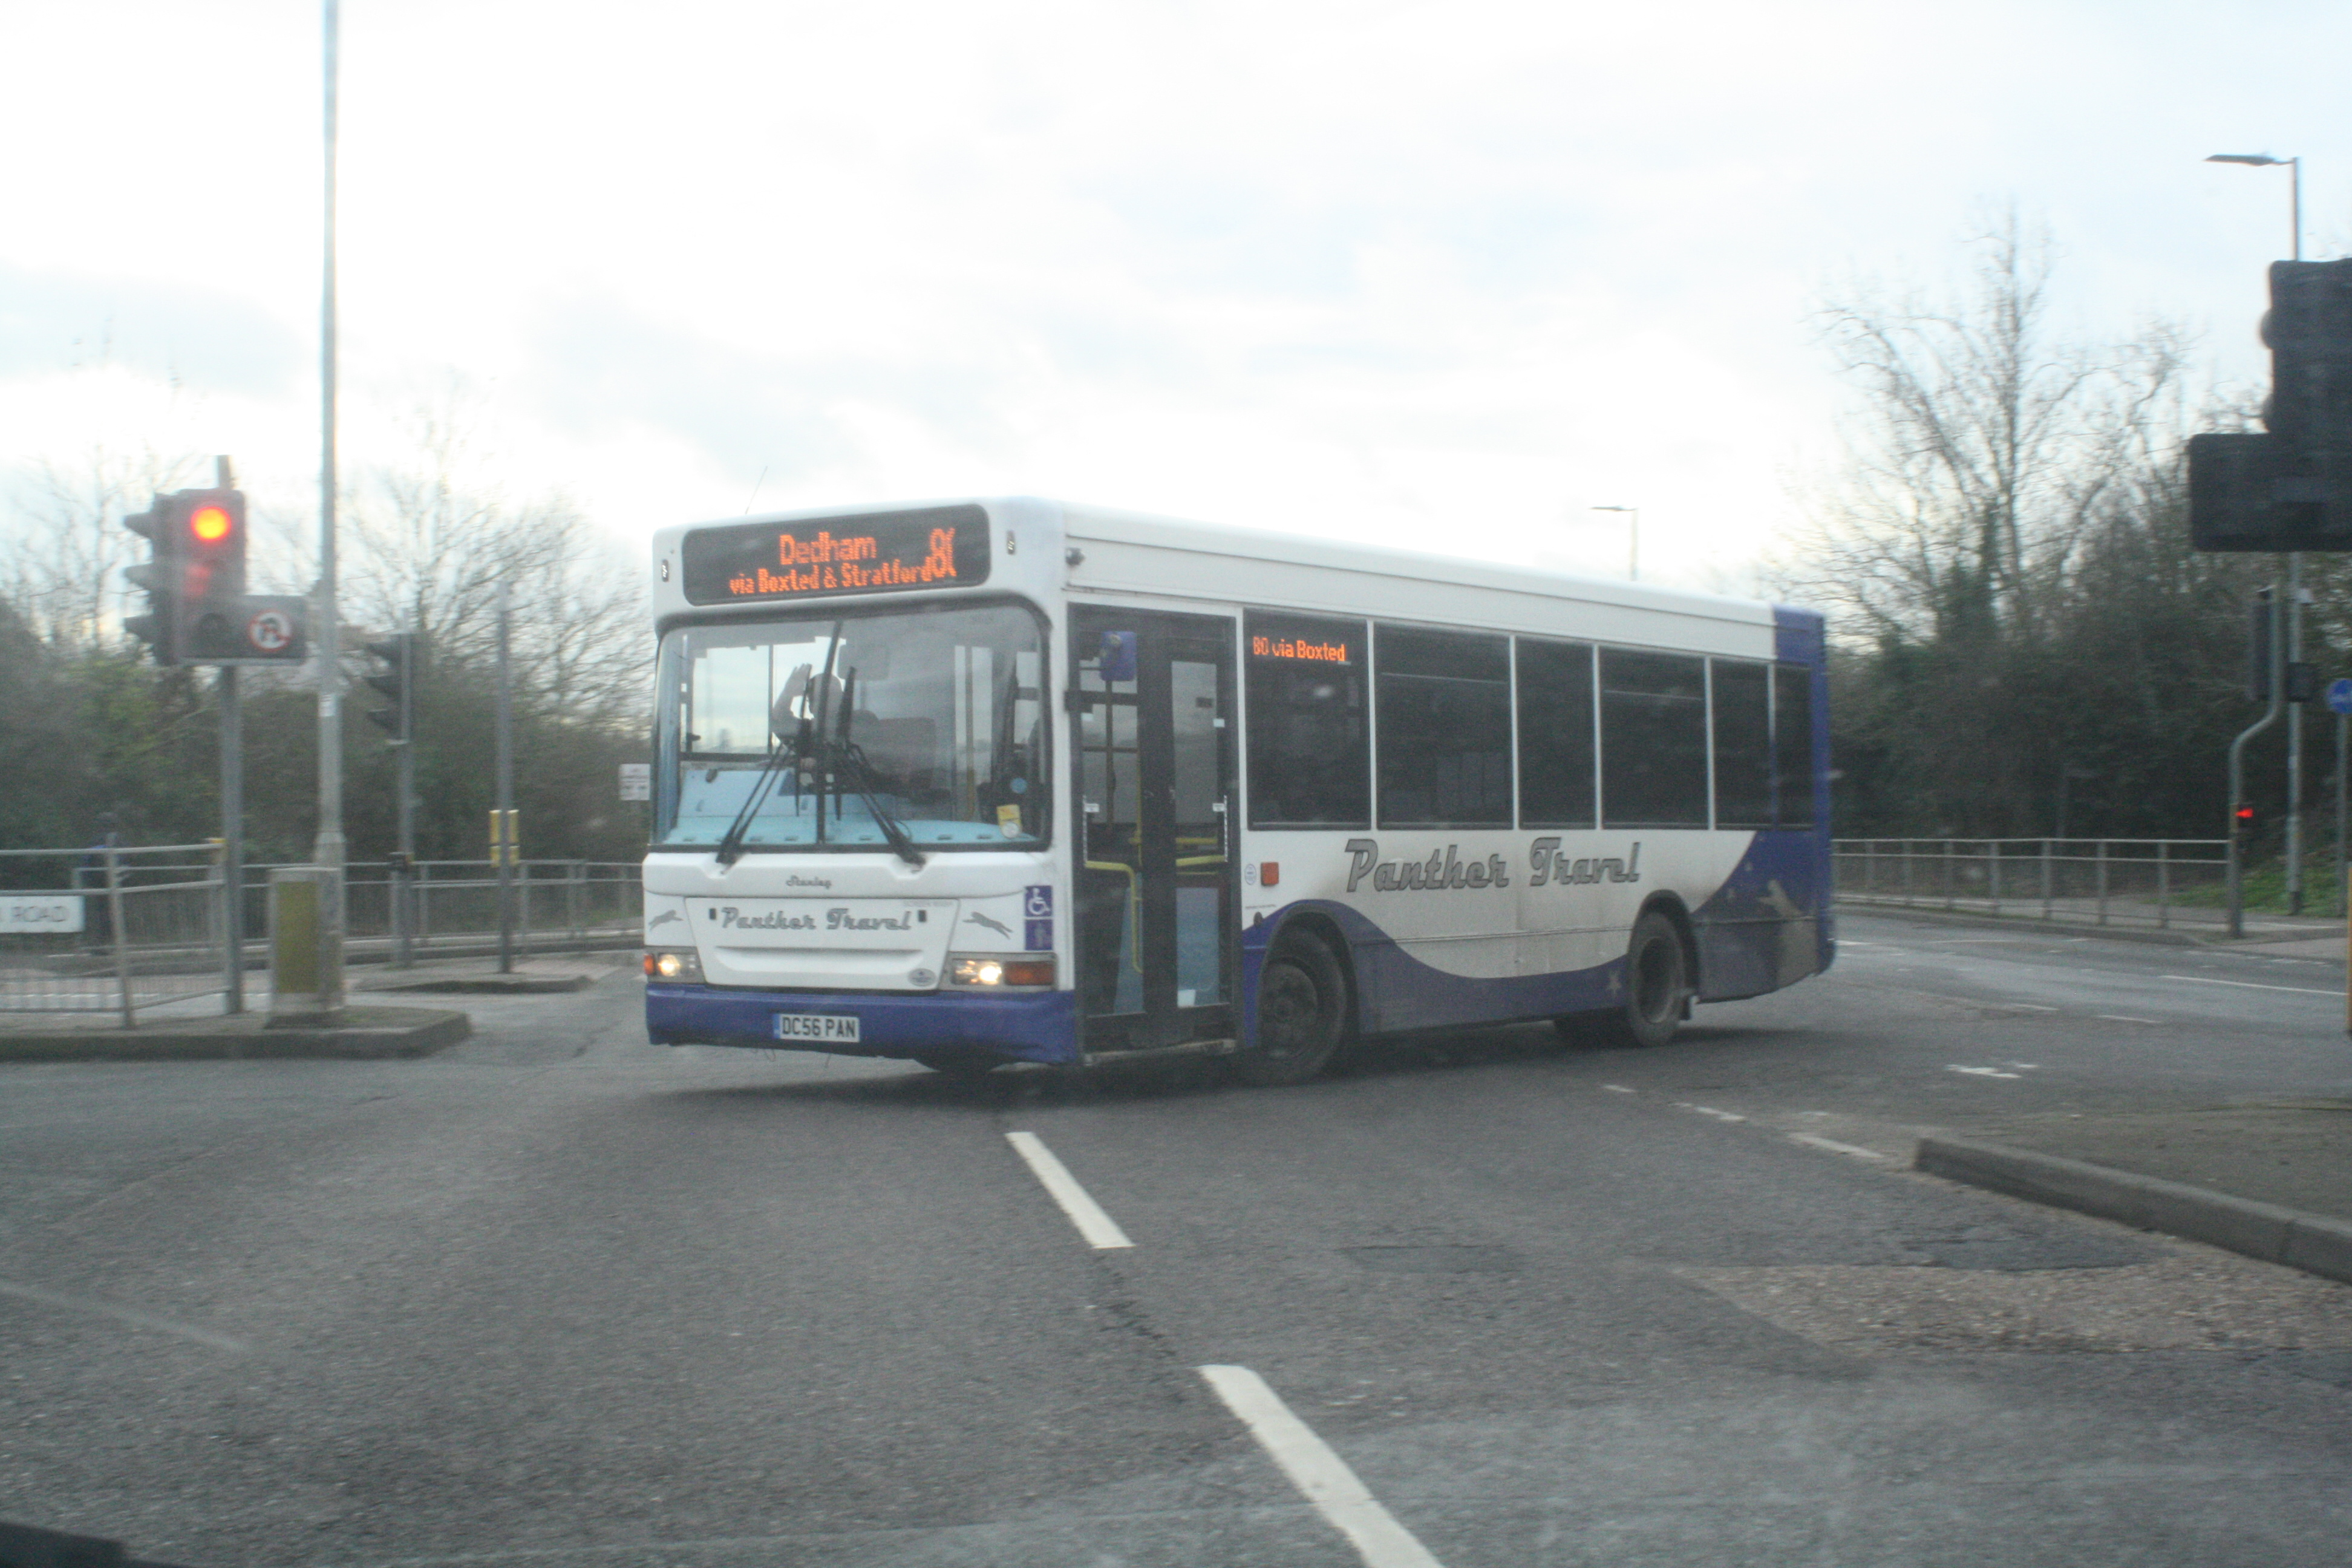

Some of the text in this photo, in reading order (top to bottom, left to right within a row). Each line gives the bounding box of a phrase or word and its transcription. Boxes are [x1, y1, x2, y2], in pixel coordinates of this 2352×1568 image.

[779, 531, 877, 565] Dedham
[730, 558, 932, 595] via Boxted & Stratford
[1272, 639, 1295, 658] via
[1296, 639, 1347, 662] Boxted
[1345, 837, 1641, 892] Panther Travel
[11, 906, 68, 923] ROAD
[722, 906, 912, 930] Panther Travel
[782, 1016, 855, 1037] DC56 PAN
